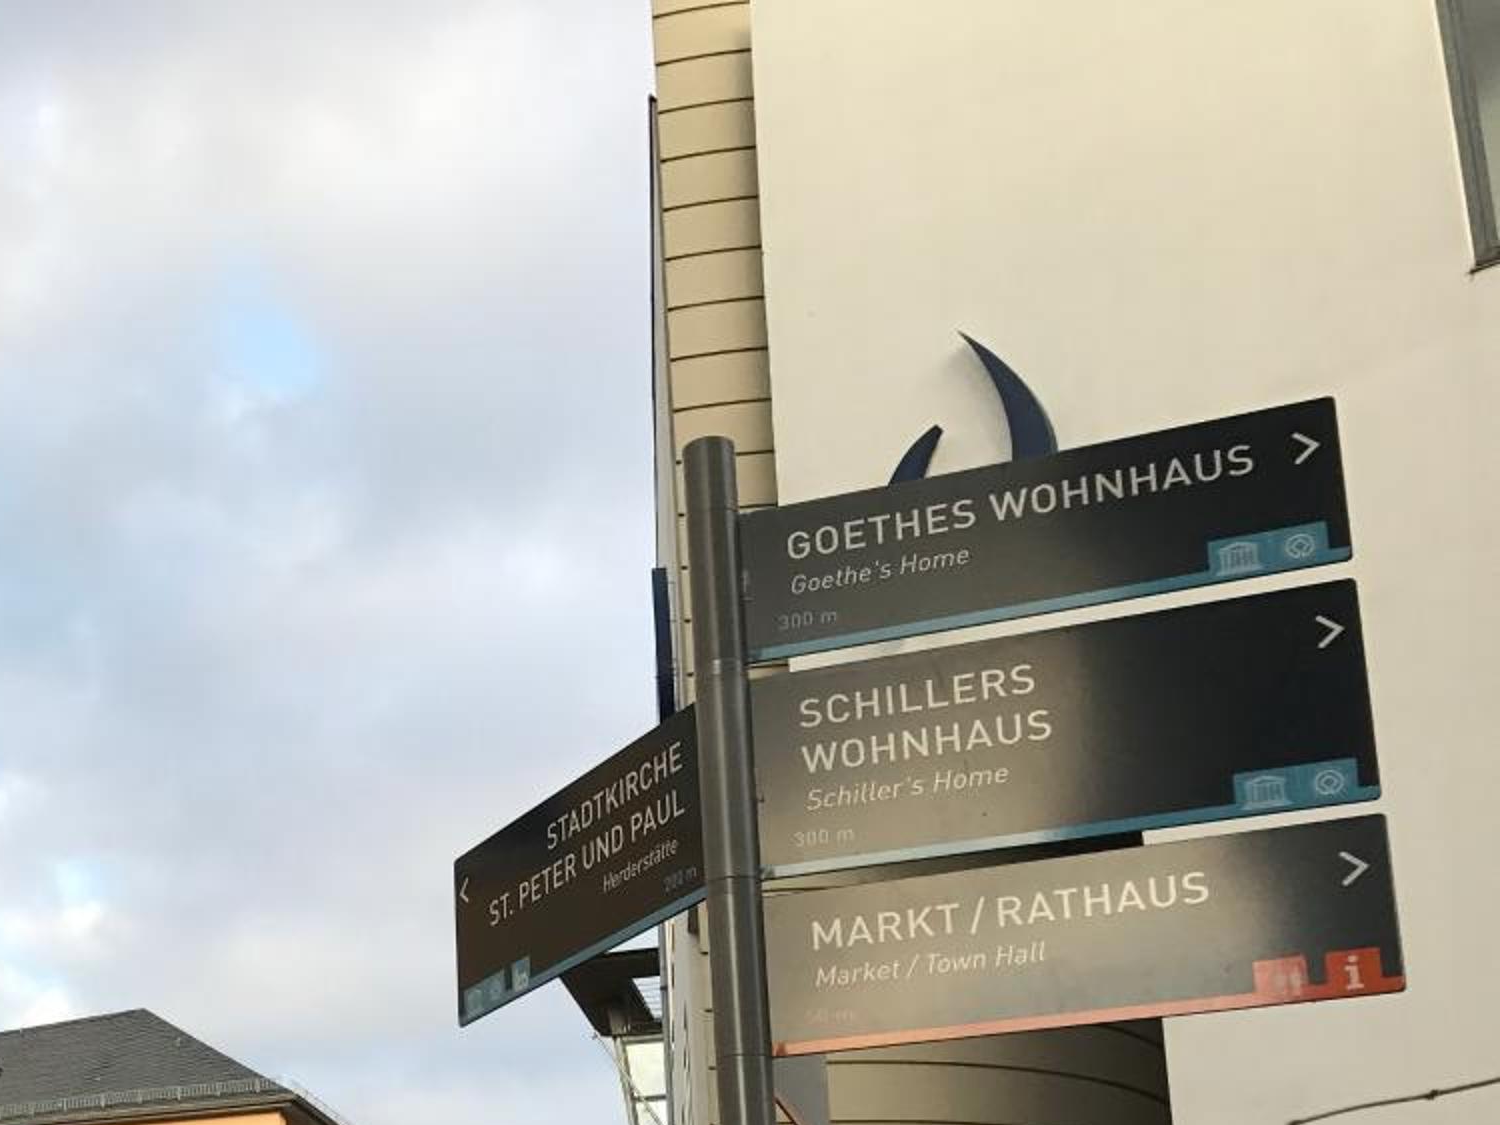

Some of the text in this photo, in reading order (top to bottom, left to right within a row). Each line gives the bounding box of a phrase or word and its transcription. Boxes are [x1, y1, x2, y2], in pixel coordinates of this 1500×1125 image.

[787, 444, 1255, 560] GOETHES WOHNHAUS
[790, 546, 970, 596] Goethe's Home
[778, 611, 837, 630] 300 m
[799, 663, 1037, 729] SCHILLERS
[800, 709, 1054, 774] WOHNHAUS
[547, 741, 684, 850] STADTKIRCHE
[806, 765, 1009, 812] Schiller's Home
[489, 789, 686, 927] ST. PETER UND PAUL
[793, 825, 855, 849] 300 m
[810, 870, 1211, 952] MARKT / RATHAUS
[814, 940, 1046, 987] Market / Town Hall
